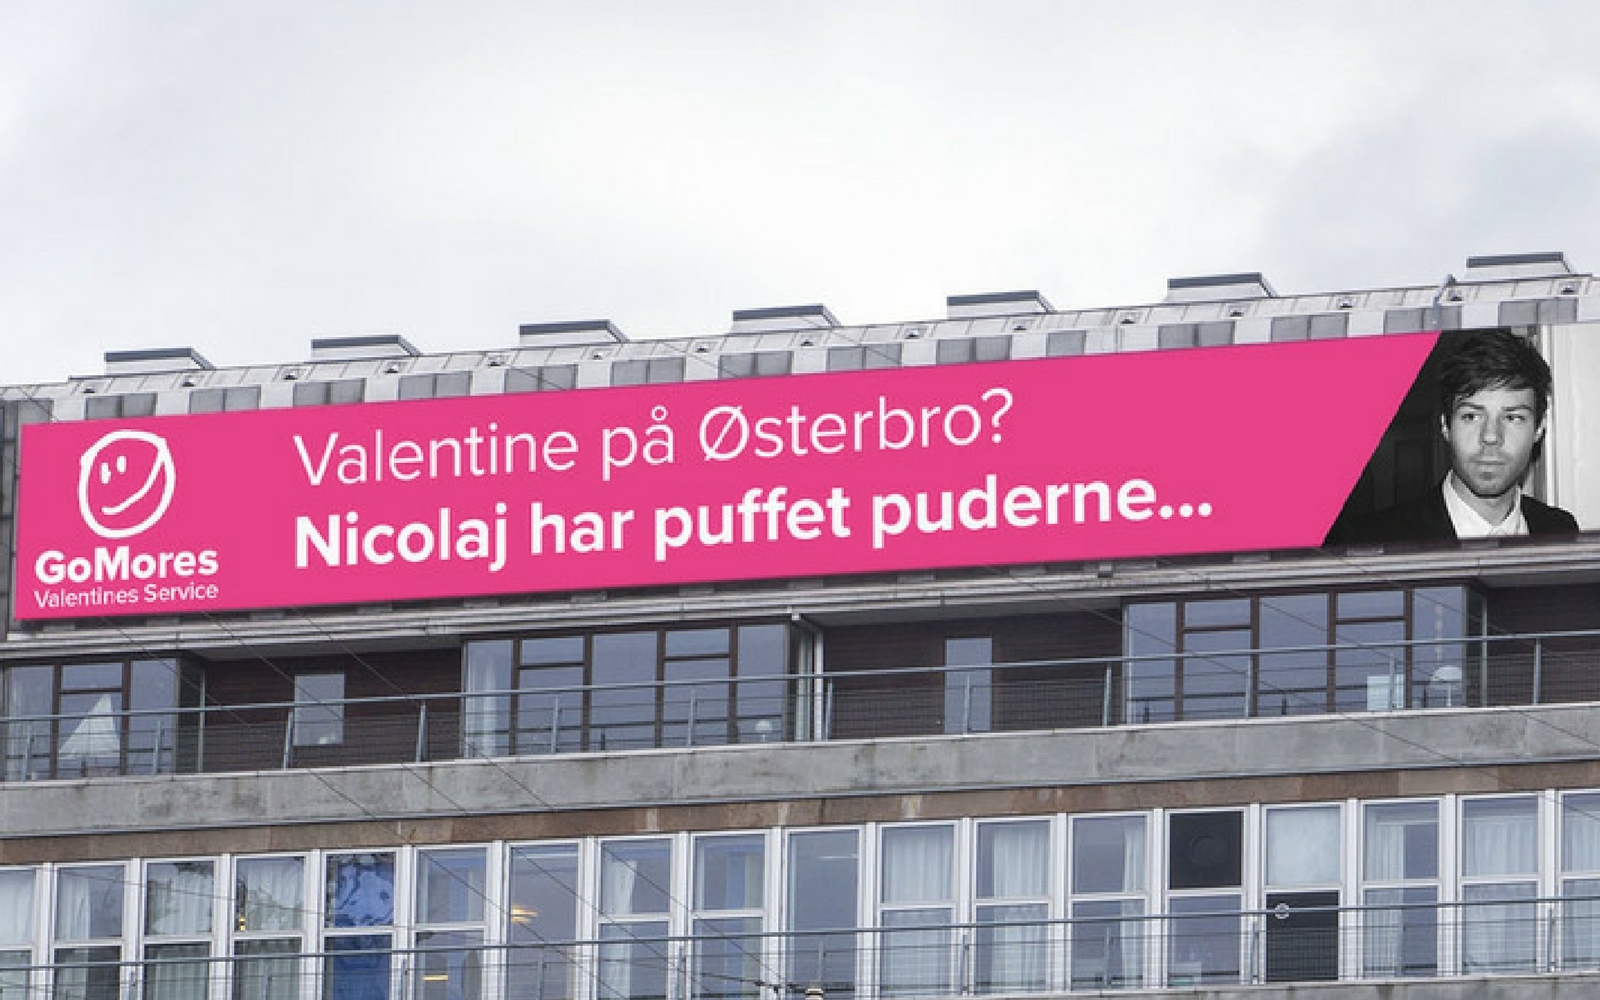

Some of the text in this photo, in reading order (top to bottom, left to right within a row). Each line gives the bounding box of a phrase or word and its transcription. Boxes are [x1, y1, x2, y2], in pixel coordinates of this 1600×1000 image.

[293, 387, 1013, 486] Valentine på Østerbro?
[294, 473, 1213, 572] Nicolaj har puffet puderne...
[33, 583, 219, 609] Valentines Service
[35, 545, 219, 585] GoMores
